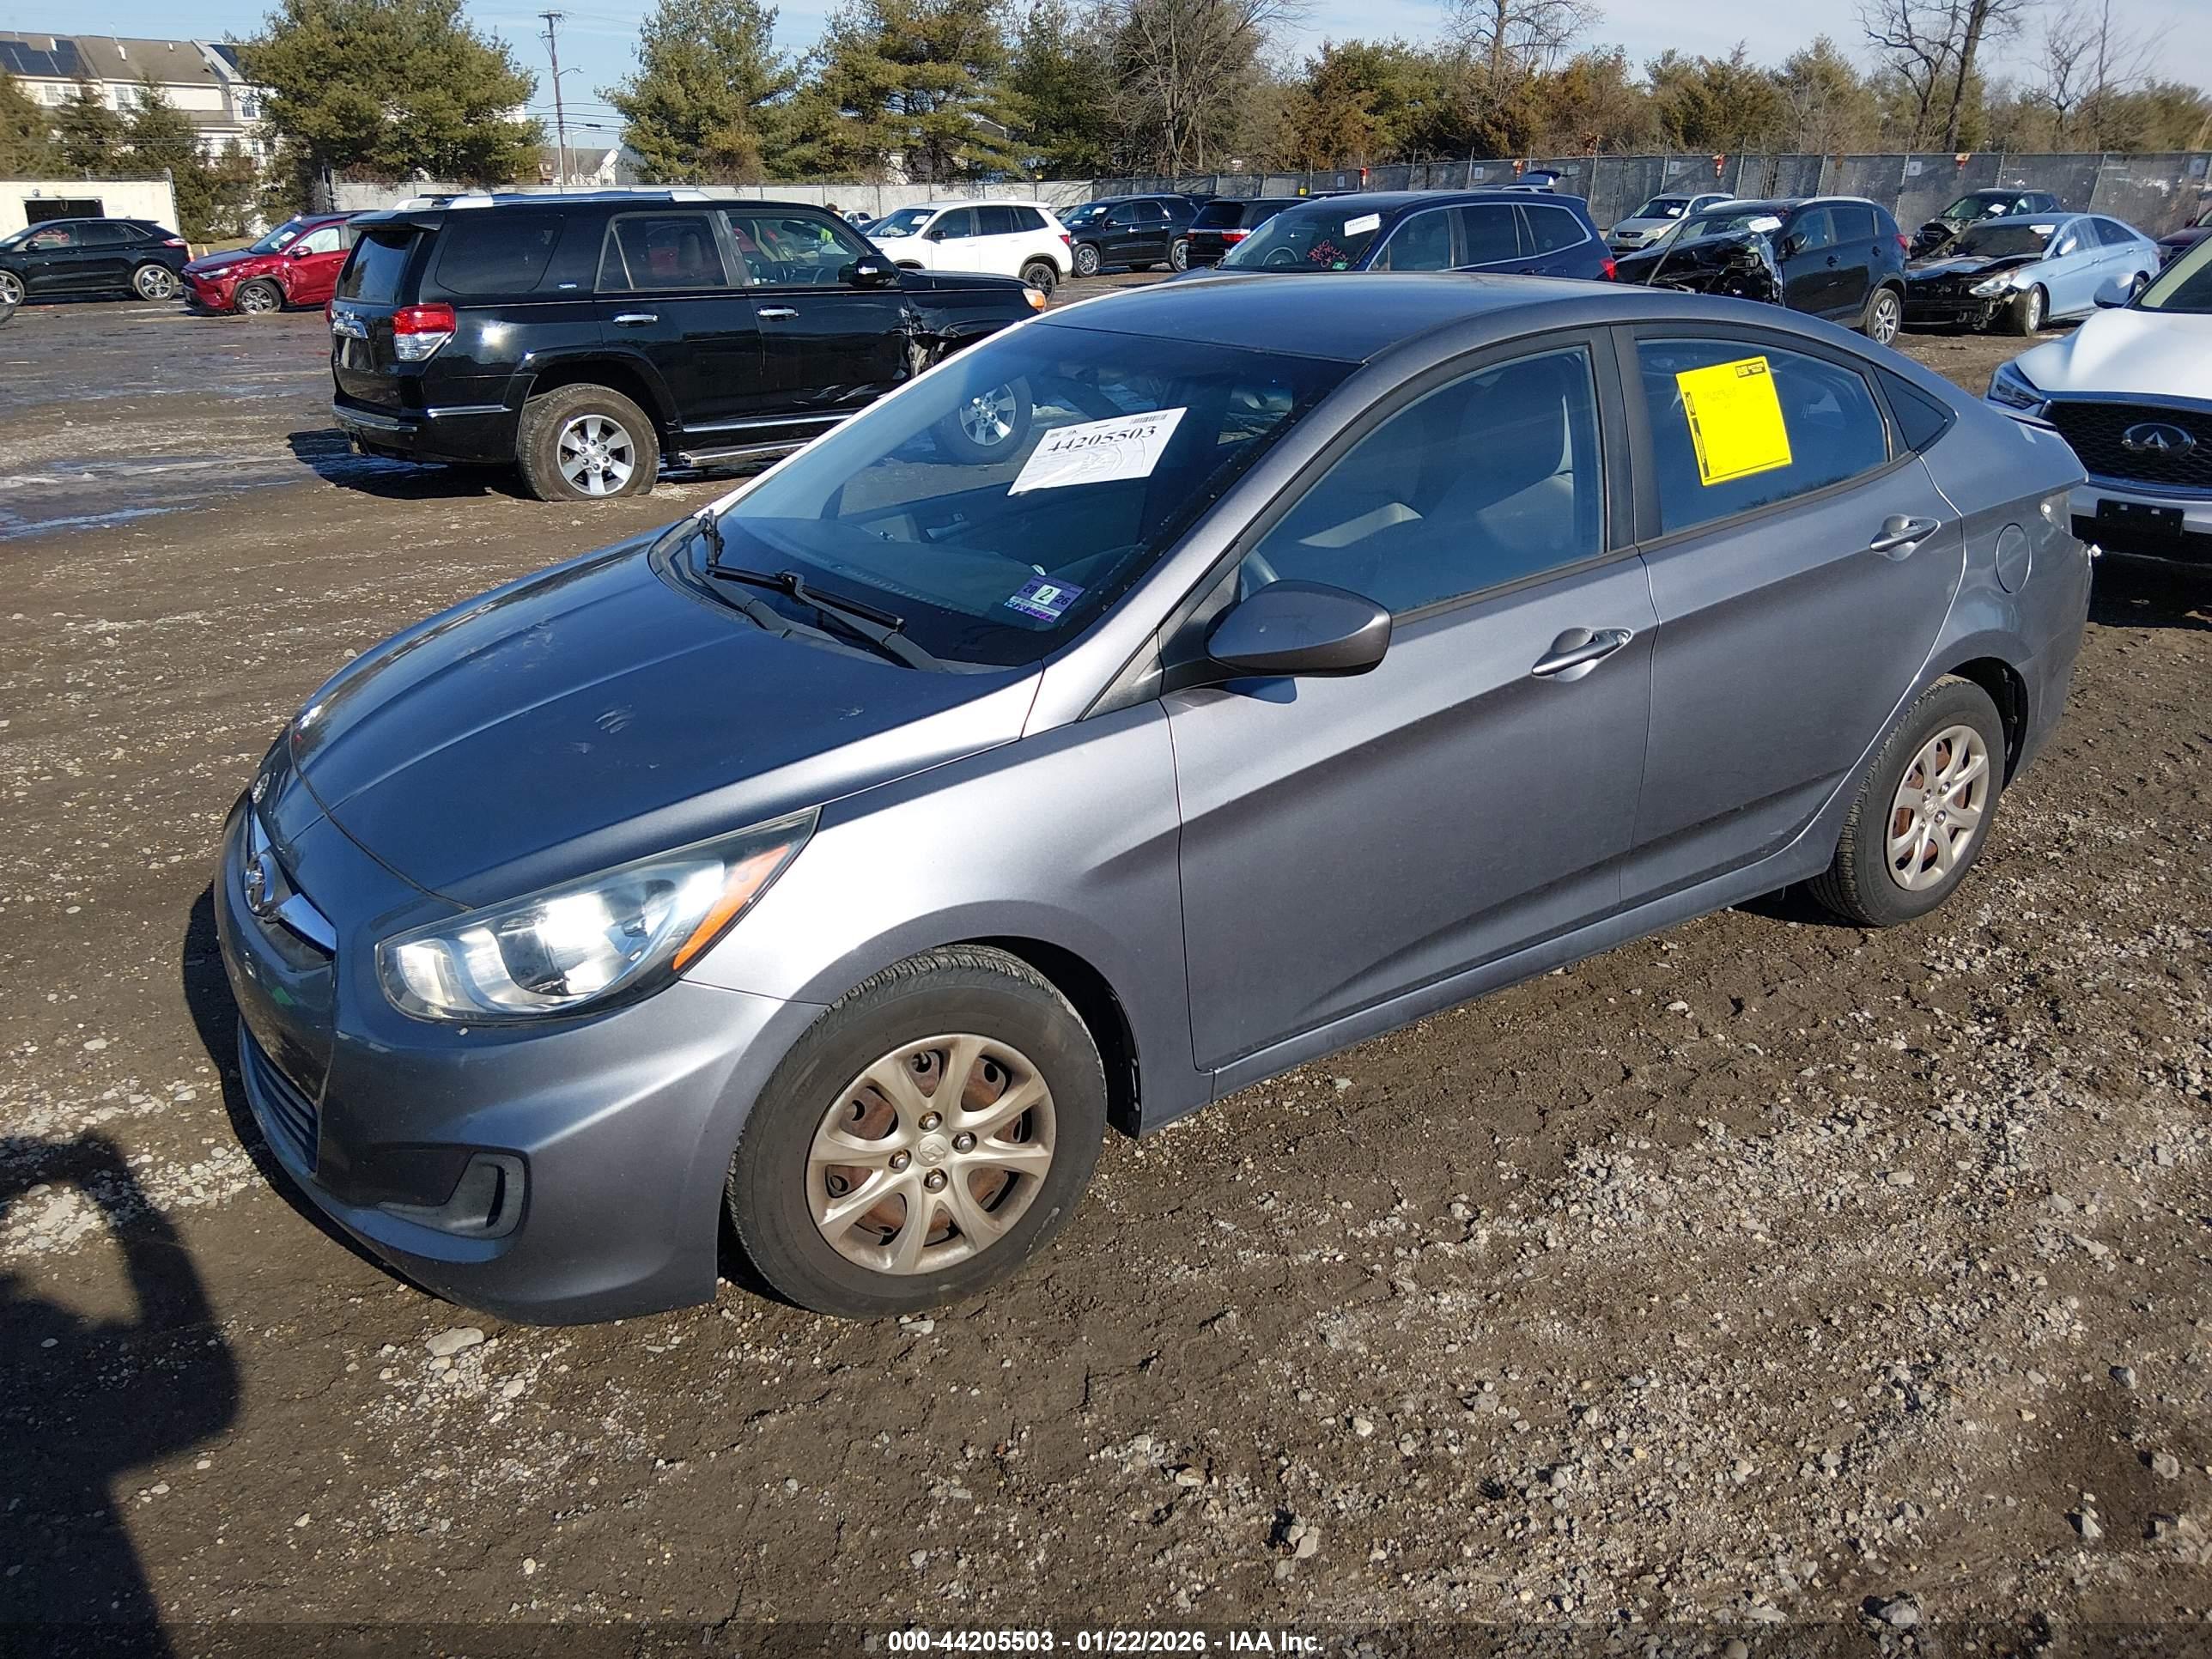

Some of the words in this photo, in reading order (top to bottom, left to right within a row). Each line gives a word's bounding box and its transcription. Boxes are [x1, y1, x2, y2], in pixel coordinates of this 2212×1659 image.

[1047, 425, 1157, 453] 44205503
[1038, 588, 1053, 601] 2
[1054, 594, 1071, 605] 26
